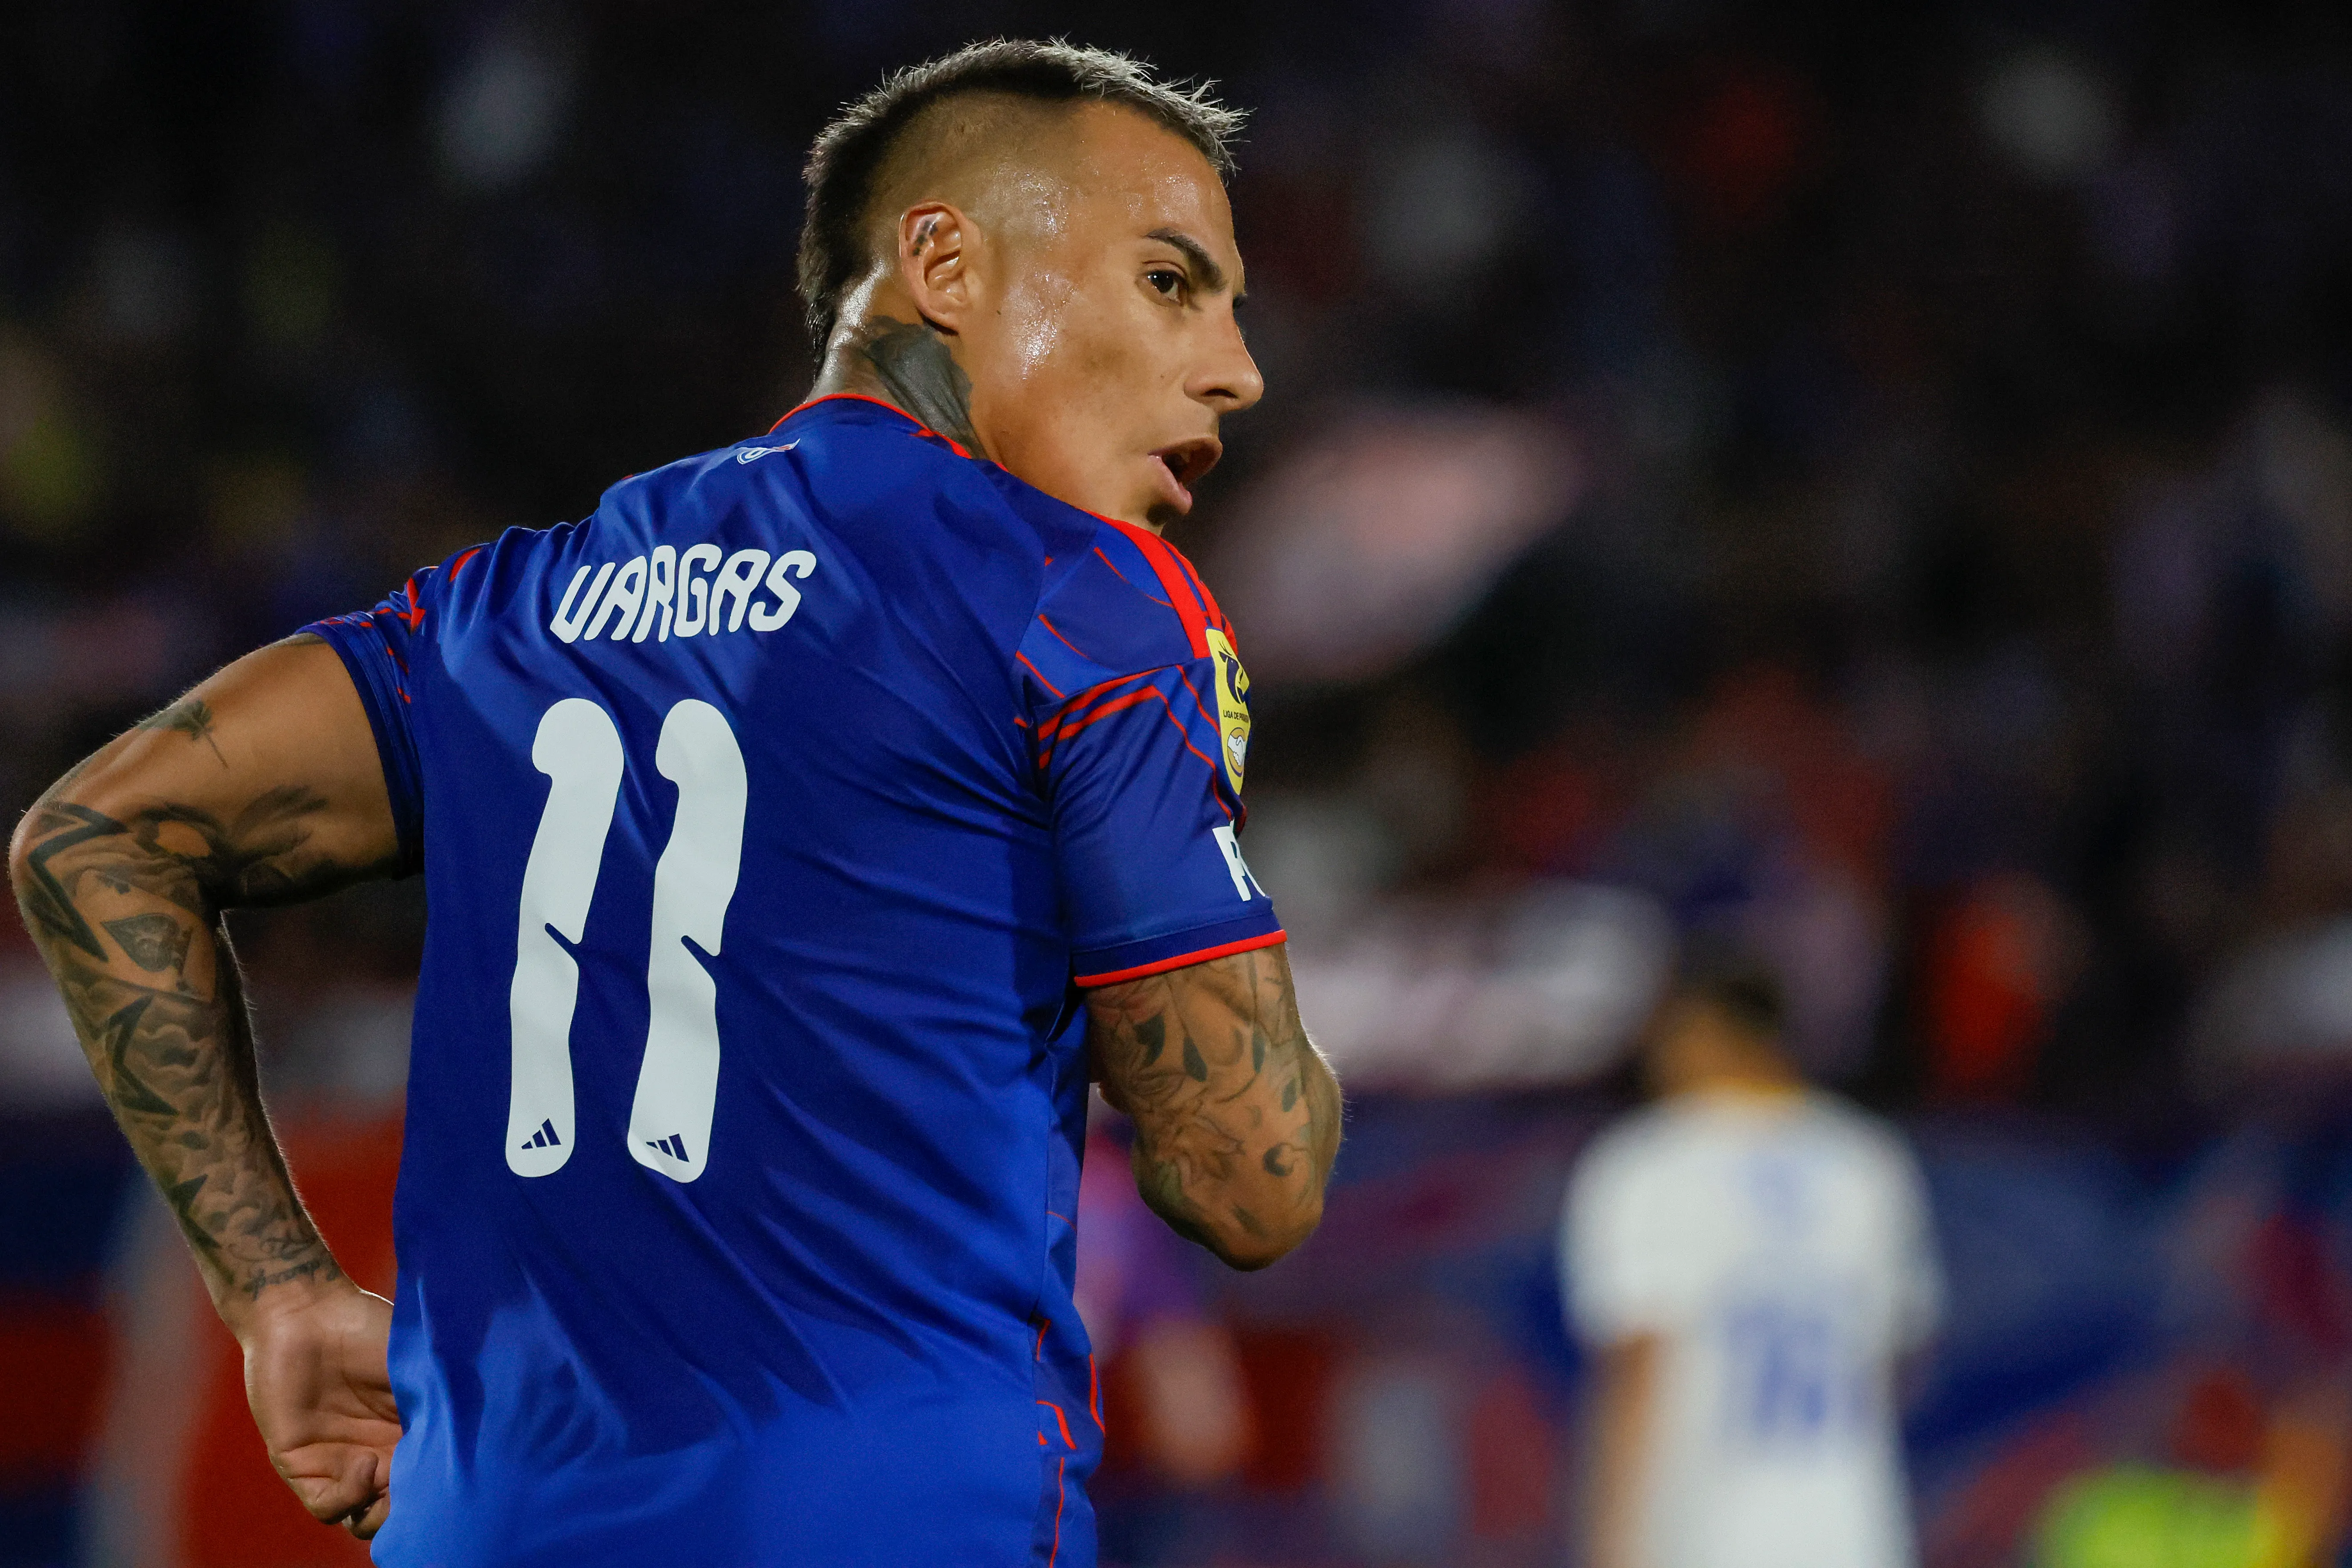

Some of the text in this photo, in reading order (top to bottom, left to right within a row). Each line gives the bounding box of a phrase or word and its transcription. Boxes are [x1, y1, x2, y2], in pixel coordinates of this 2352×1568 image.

[550, 543, 816, 643] VARGAS
[1223, 710, 1233, 719] LIGA
[1234, 712, 1239, 720] DE
[505, 698, 748, 1183] 11
